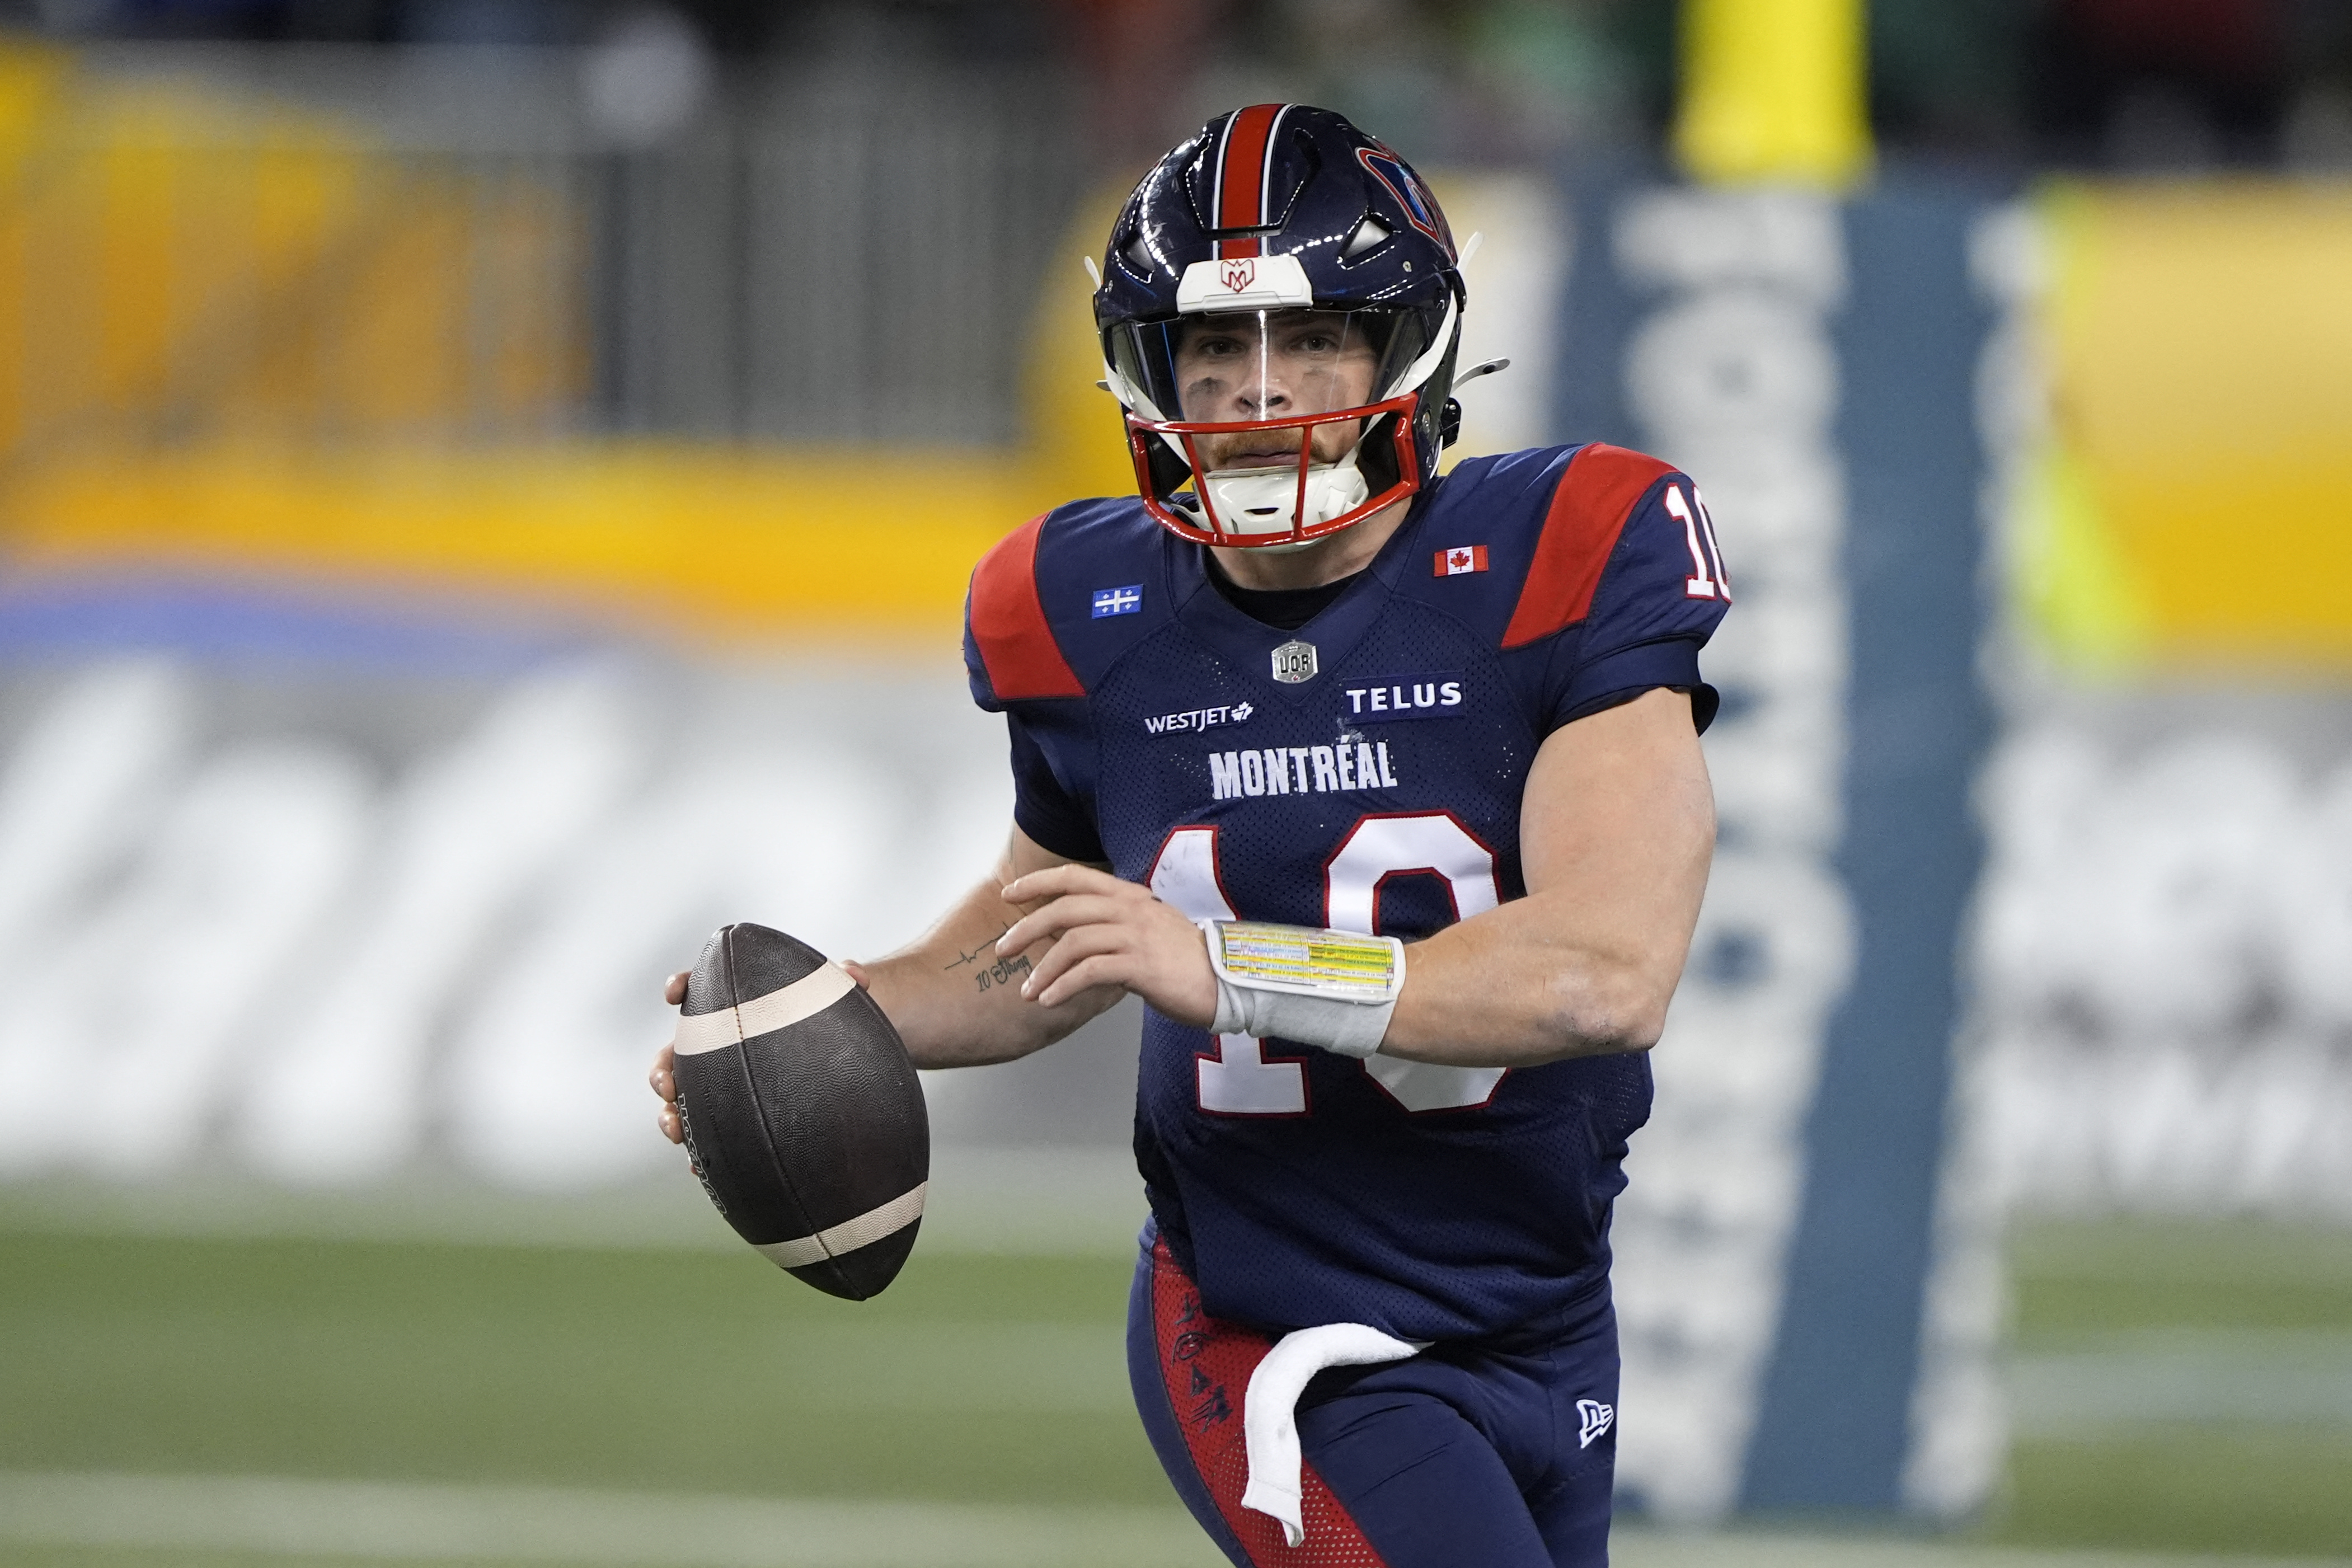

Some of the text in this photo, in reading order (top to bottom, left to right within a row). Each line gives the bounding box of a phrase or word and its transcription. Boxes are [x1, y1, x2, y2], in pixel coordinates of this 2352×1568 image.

[1346, 682, 1462, 713] TELUS
[1144, 706, 1231, 734] WESTJET
[1209, 735, 1398, 800] MONTRÉAL
[1145, 810, 1512, 1118] 10
[975, 970, 990, 992] 10
